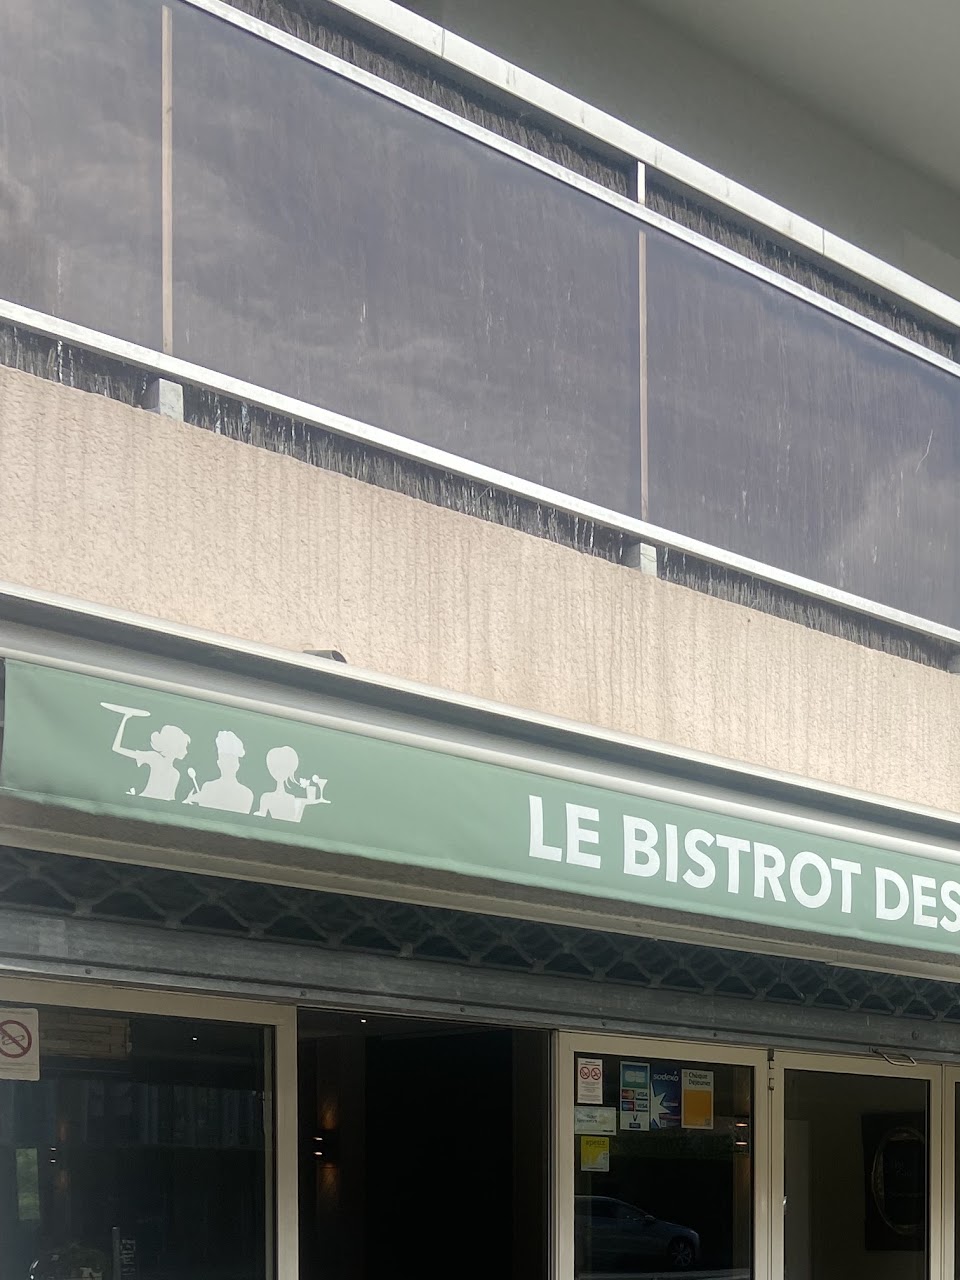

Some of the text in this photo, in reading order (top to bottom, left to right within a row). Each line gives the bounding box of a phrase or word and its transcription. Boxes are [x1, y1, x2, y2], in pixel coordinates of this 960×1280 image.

[528, 794, 601, 869] LE
[622, 814, 862, 914] BISTROT
[653, 1071, 679, 1082] sodexo
